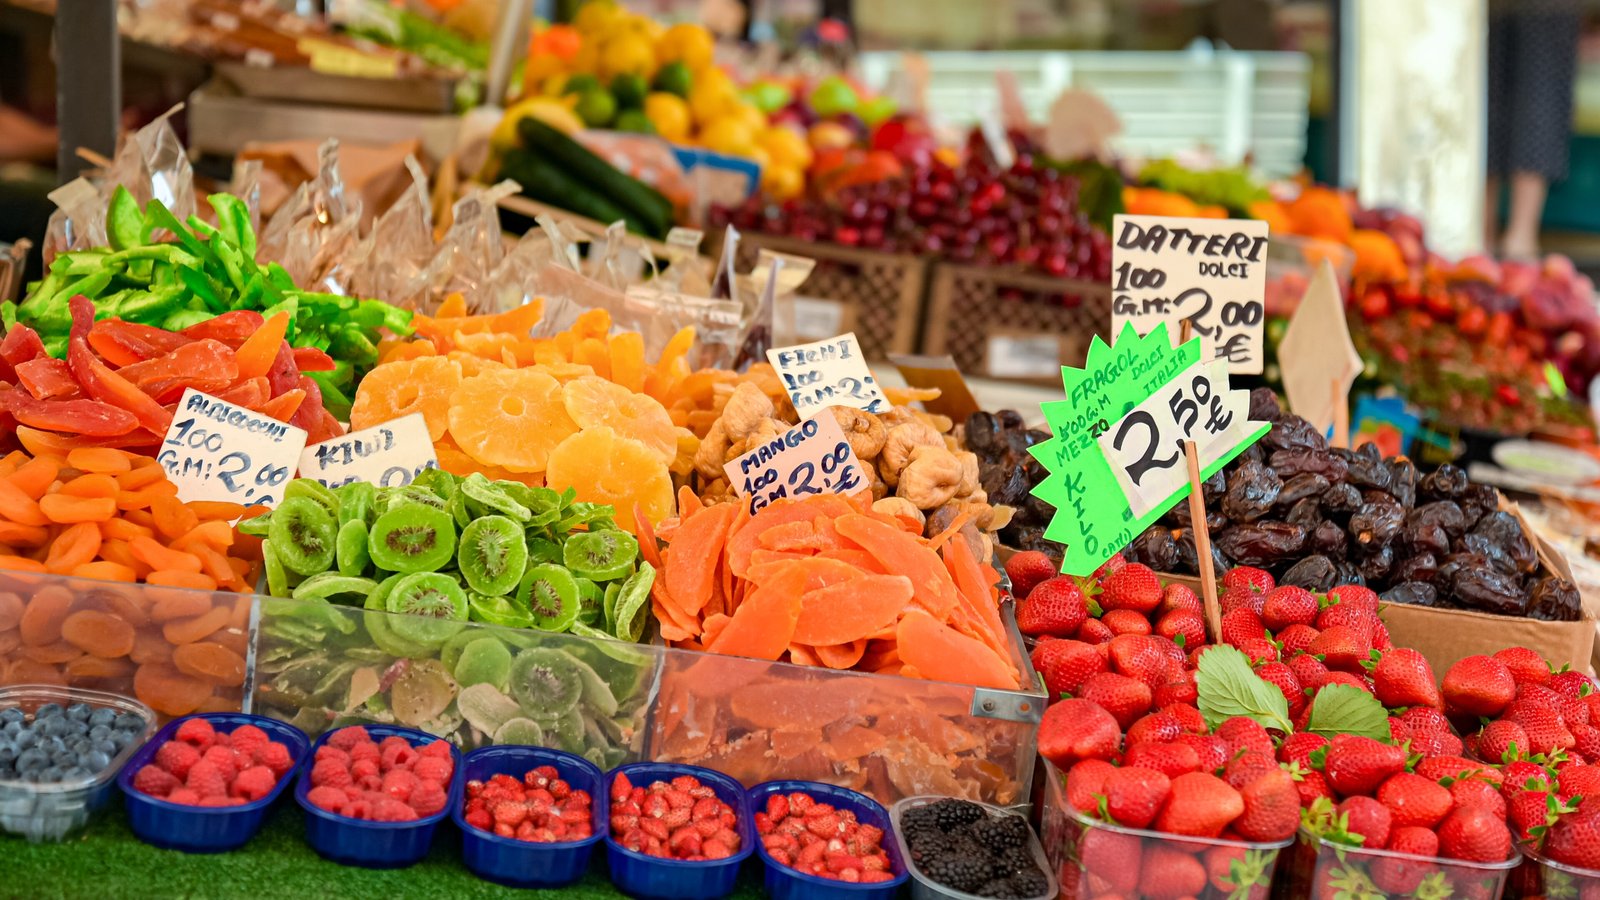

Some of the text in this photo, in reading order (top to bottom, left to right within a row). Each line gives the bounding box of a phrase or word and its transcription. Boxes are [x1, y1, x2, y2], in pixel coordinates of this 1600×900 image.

[1117, 221, 1268, 262] DATTERI
[1114, 261, 1167, 291] 100
[1199, 262, 1248, 279] DOLCI
[1173, 288, 1263, 341] 2,00
[1132, 345, 1165, 380] DOLCI
[1215, 333, 1252, 363] €
[783, 370, 824, 391] 100
[1071, 348, 1139, 409] FRAGOL
[1143, 349, 1187, 396] ITALIA
[165, 418, 223, 452] 100
[315, 429, 394, 470] KIWI
[741, 420, 818, 474] MANGO
[1056, 419, 1110, 467] MEZZO
[1113, 375, 1233, 487] 2,50 €
[744, 468, 778, 496] 100
[788, 442, 860, 495] 2,00 €
[1064, 471, 1098, 556] KILO
